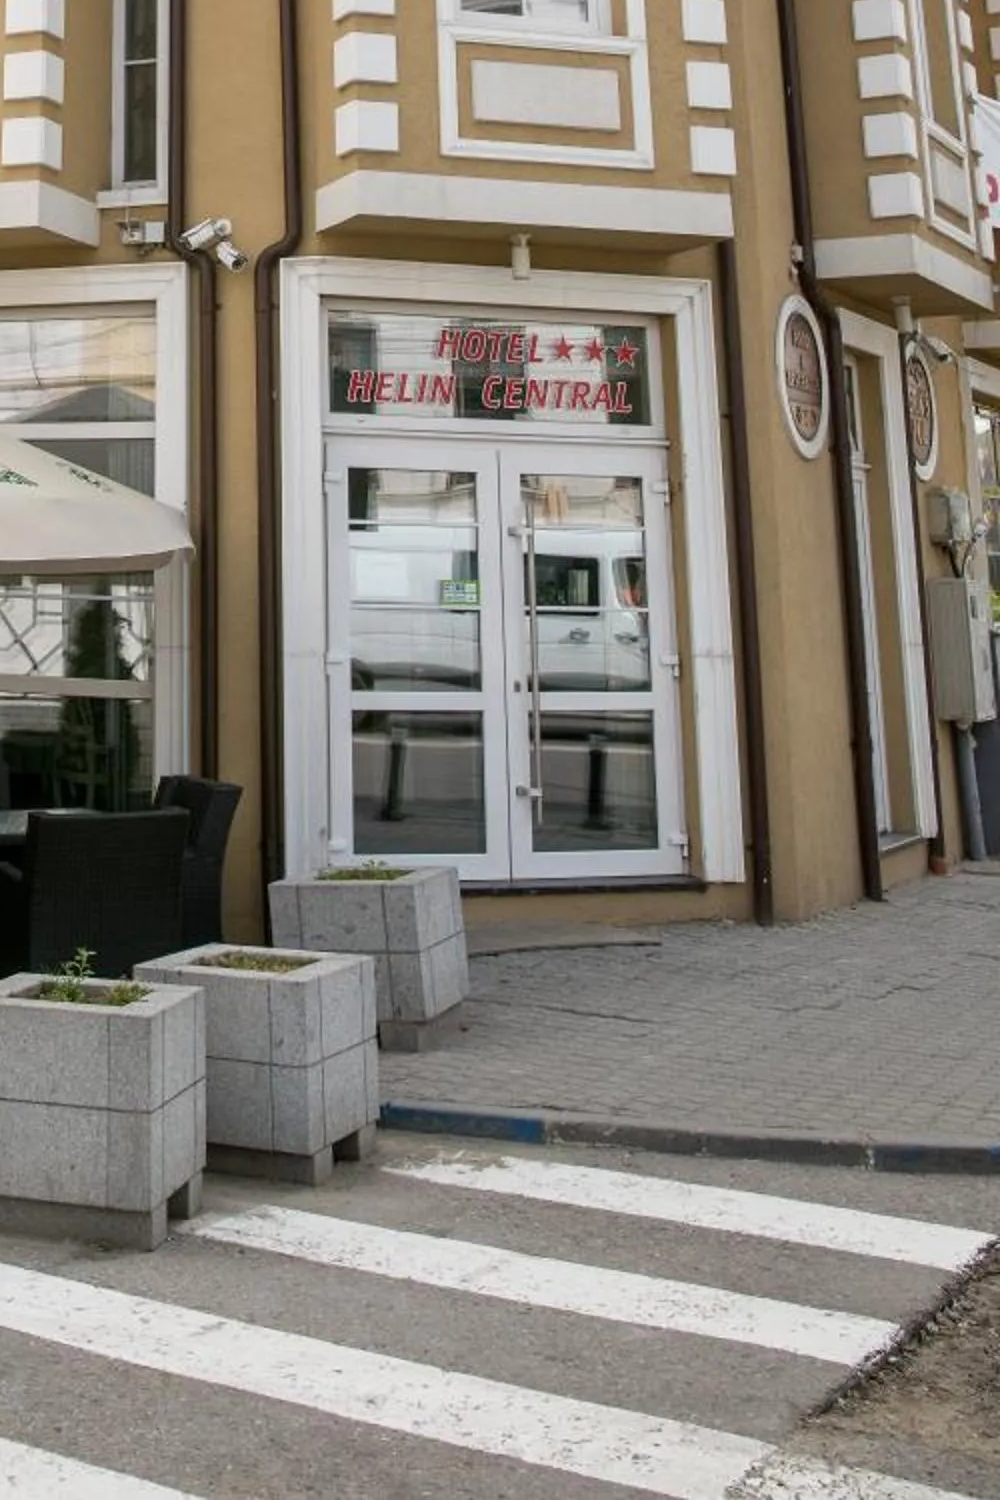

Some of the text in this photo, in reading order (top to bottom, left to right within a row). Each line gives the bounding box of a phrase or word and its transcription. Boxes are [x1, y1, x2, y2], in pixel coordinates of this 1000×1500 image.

[437, 329, 544, 364] HOTEL
[347, 369, 633, 413] HELIN CENTRAL
